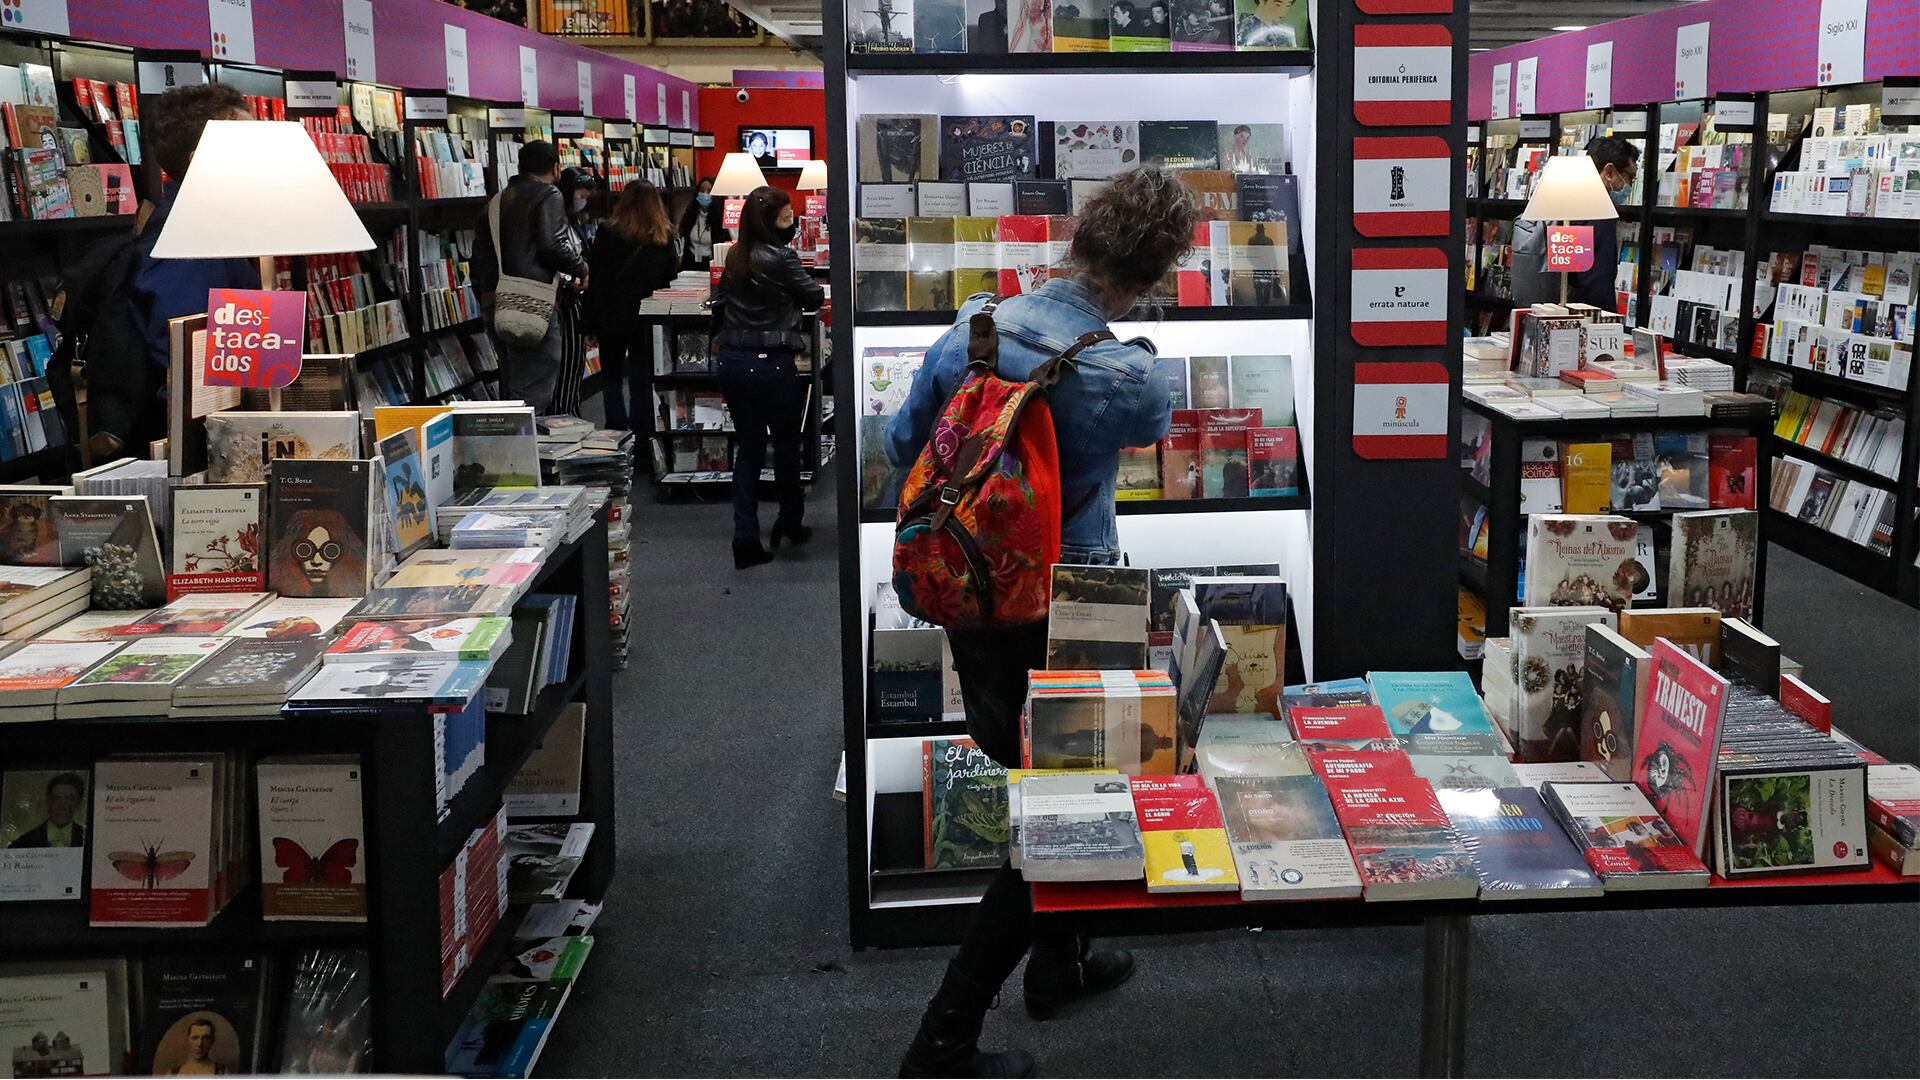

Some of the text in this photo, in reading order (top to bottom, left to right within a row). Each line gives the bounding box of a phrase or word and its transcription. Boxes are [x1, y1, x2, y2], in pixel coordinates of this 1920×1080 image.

[1827, 20, 1858, 35] Siglo XXI
[1681, 46, 1703, 59] Siglo XXI
[1368, 75, 1400, 84] EDITORIAL
[962, 141, 1005, 160] MUJERES
[963, 154, 1015, 174] CIENCIA
[1551, 231, 1578, 243] des-
[1551, 243, 1592, 256] taca-
[1551, 254, 1571, 266] dos
[1370, 300, 1430, 308] errata naturae
[214, 303, 269, 326] des-
[212, 331, 296, 350] taca-
[1590, 335, 1619, 353] SUR
[211, 350, 252, 373] dos
[1382, 418, 1420, 428] minúscula
[1566, 453, 1583, 467] 16
[1547, 538, 1582, 559] Reinas
[1583, 542, 1595, 556] del
[881, 690, 918, 698] Estambul
[881, 698, 918, 707] Estambul
[1655, 670, 1708, 737] TRAVESTI
[945, 744, 964, 762] El
[947, 763, 1009, 790] jardinero
[1601, 853, 1630, 861] Maryse
[1604, 859, 1631, 867] Condé
